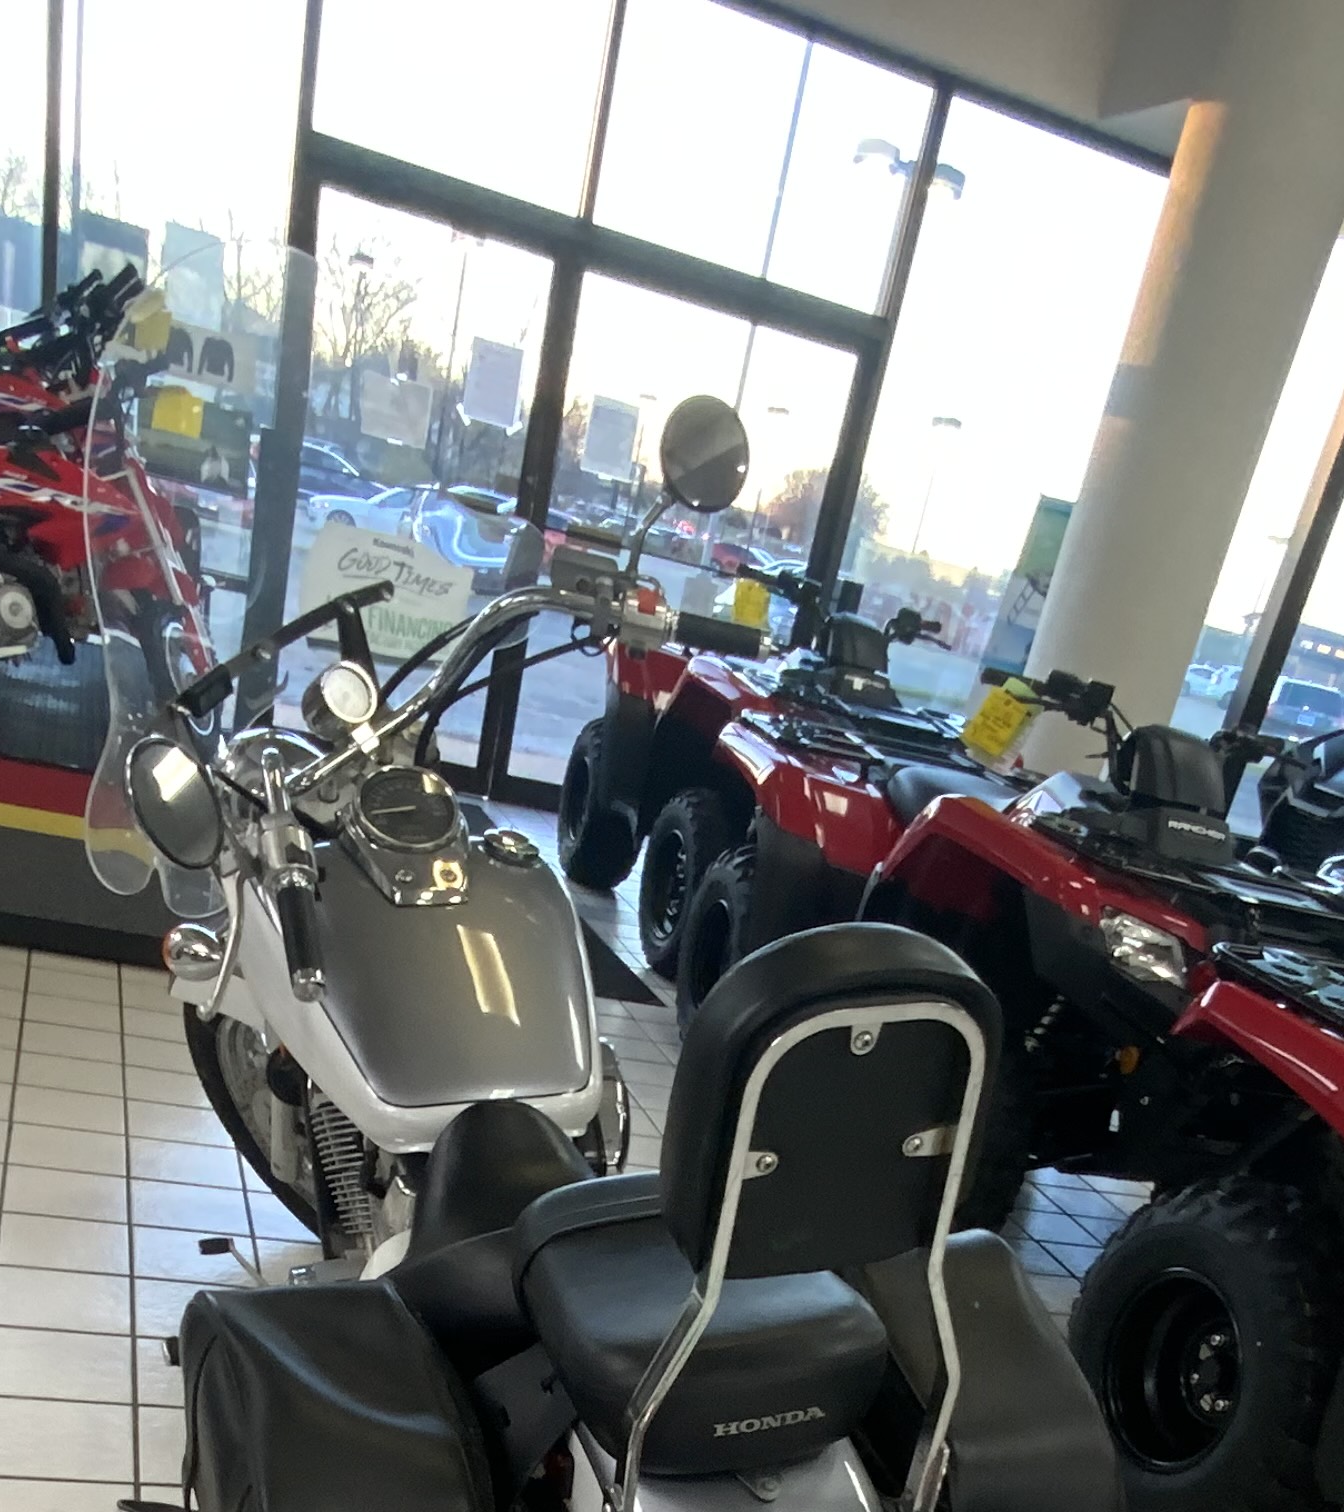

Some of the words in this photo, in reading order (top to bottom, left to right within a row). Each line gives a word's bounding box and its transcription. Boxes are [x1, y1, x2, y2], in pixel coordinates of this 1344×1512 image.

[338, 547, 391, 575] GOOD
[393, 560, 454, 597] TIMES
[1167, 820, 1226, 841] RANCHER
[713, 1406, 826, 1437] HONDA
